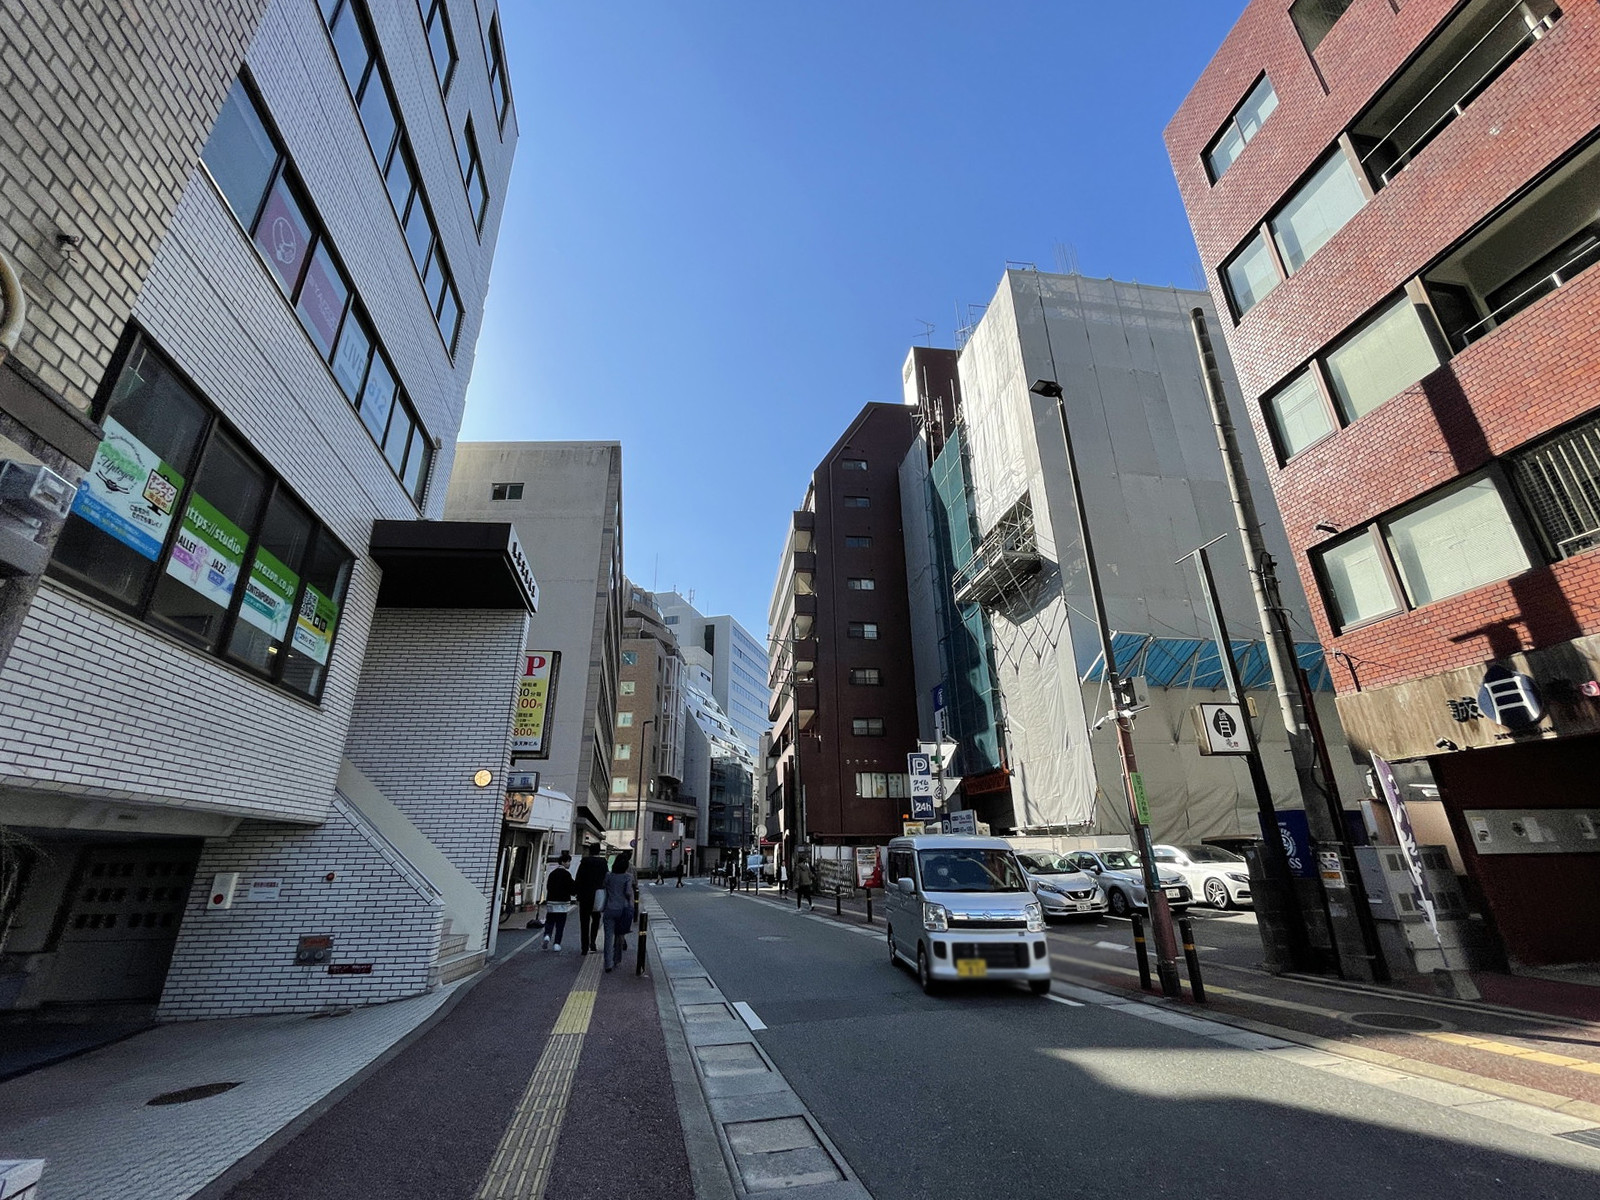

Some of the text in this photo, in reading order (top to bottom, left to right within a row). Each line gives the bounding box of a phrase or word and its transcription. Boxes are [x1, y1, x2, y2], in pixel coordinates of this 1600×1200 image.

[176, 535, 197, 554] ALLET
[211, 559, 227, 575] JAZZ
[523, 656, 546, 676] P
[912, 757, 928, 775] P
[915, 802, 932, 812] 24h
